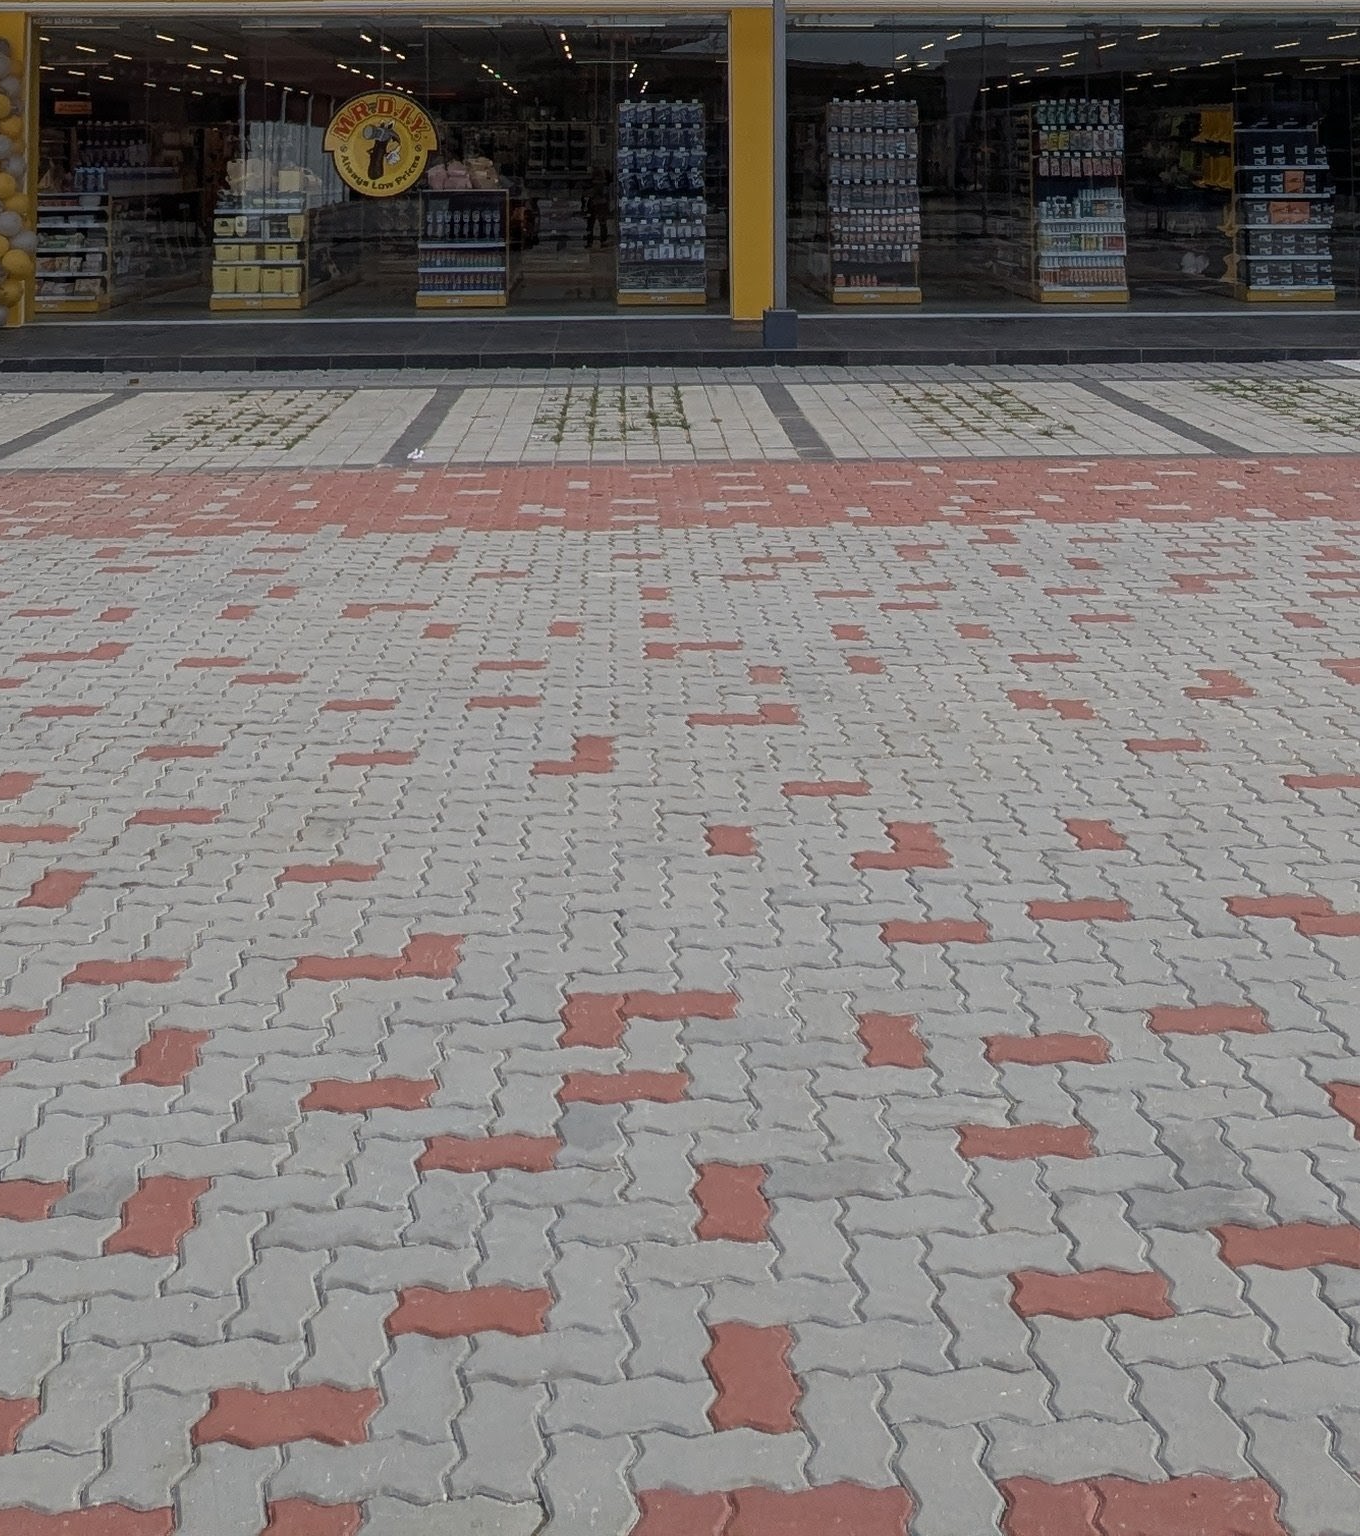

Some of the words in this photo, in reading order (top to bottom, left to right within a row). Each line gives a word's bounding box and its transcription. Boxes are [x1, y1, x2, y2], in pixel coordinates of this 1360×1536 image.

[340, 155, 369, 187] Always
[371, 181, 394, 190] Low
[394, 155, 421, 185] Prices
